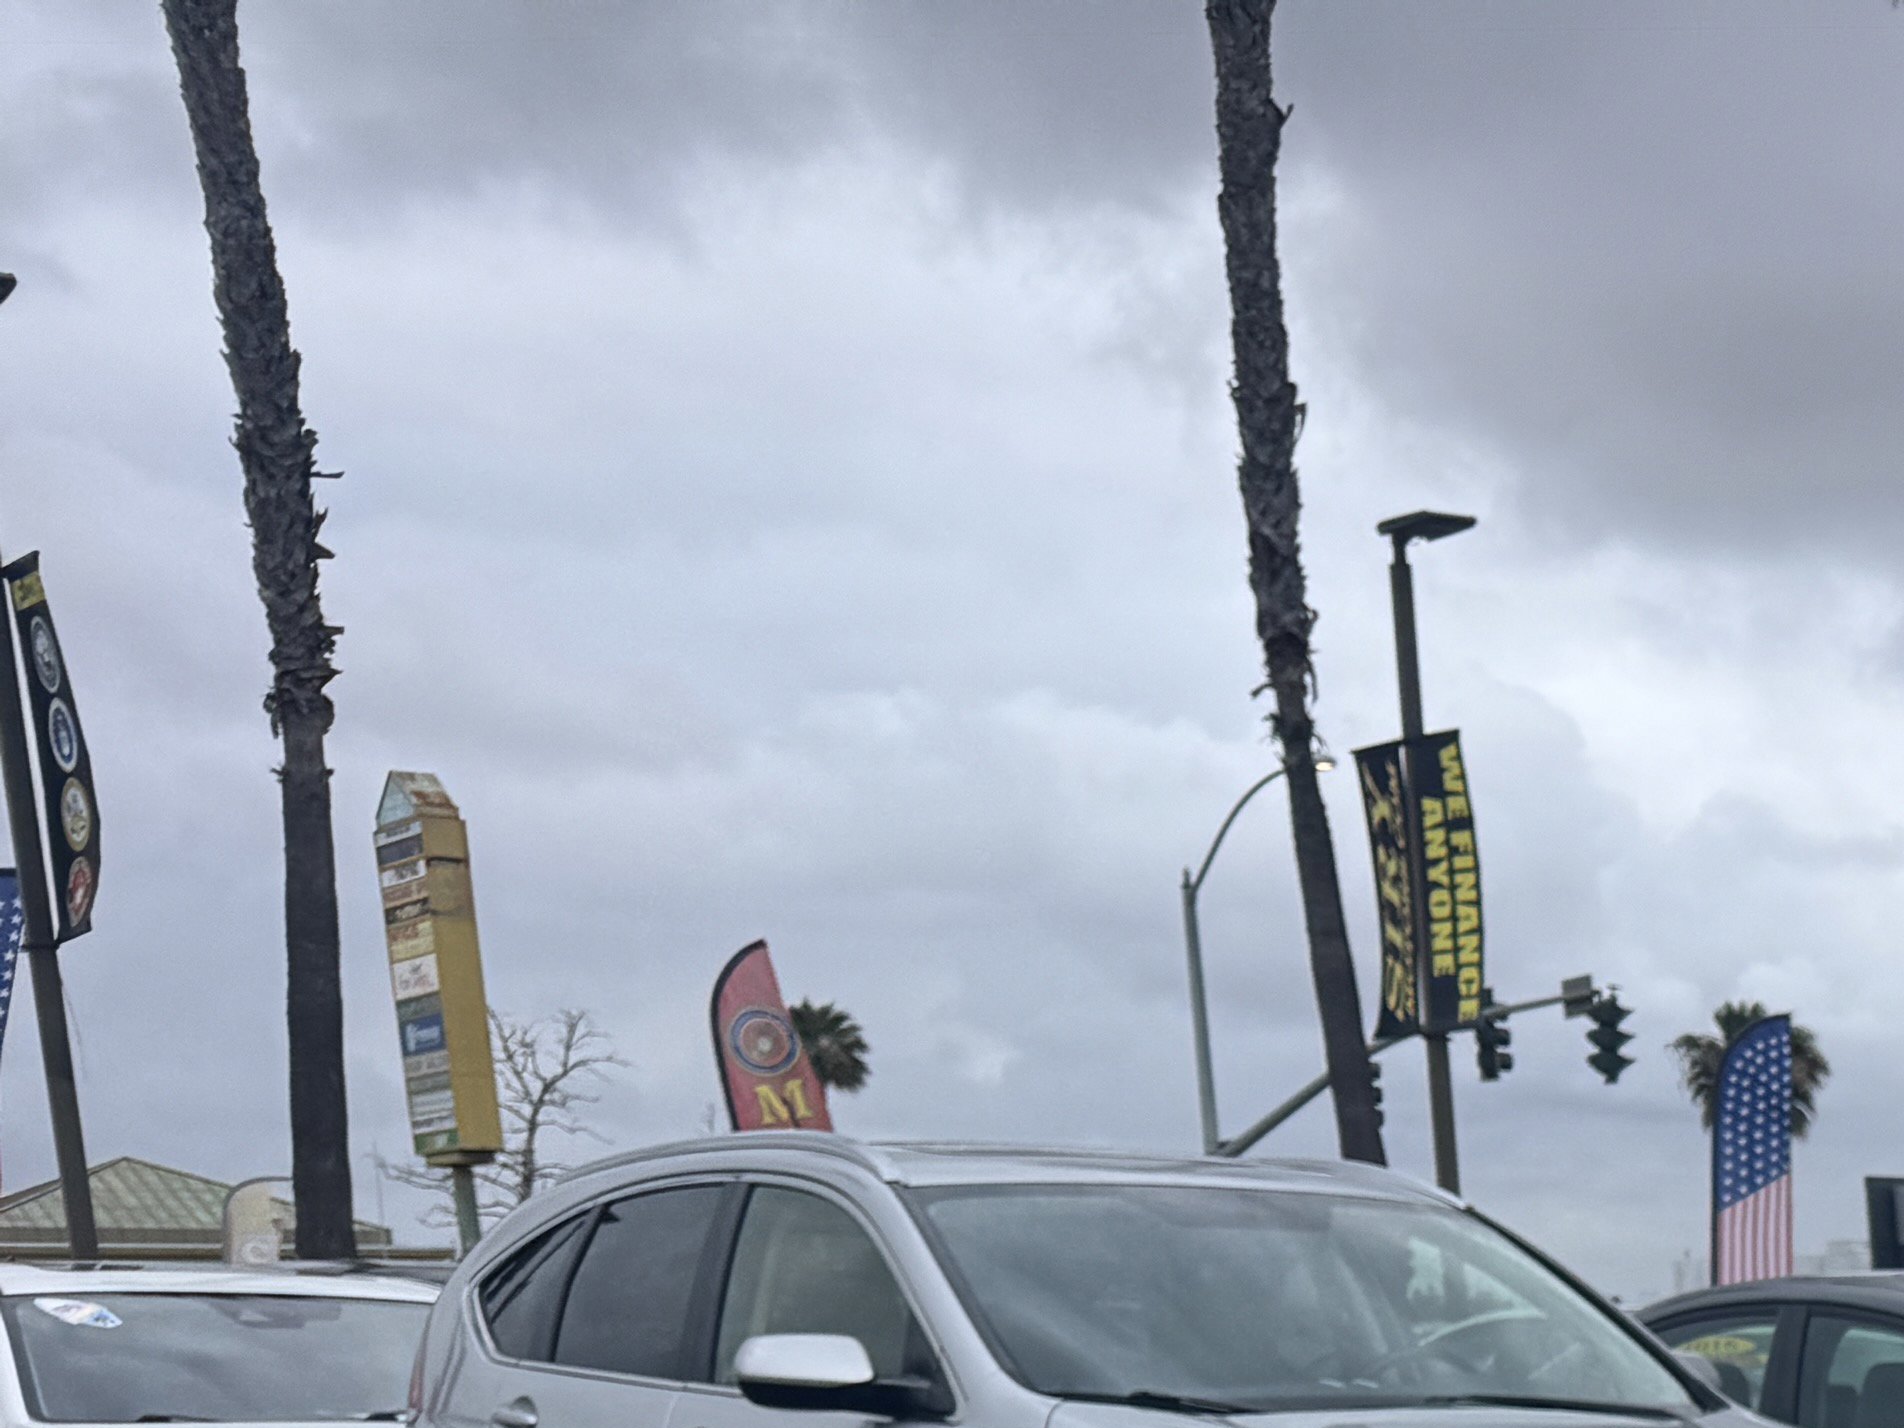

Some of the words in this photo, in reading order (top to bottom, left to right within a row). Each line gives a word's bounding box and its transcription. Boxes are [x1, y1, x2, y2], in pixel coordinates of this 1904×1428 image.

[1437, 740, 1470, 821] WE
[1420, 796, 1456, 978] ANYONE
[1450, 829, 1481, 1024] FINANCE
